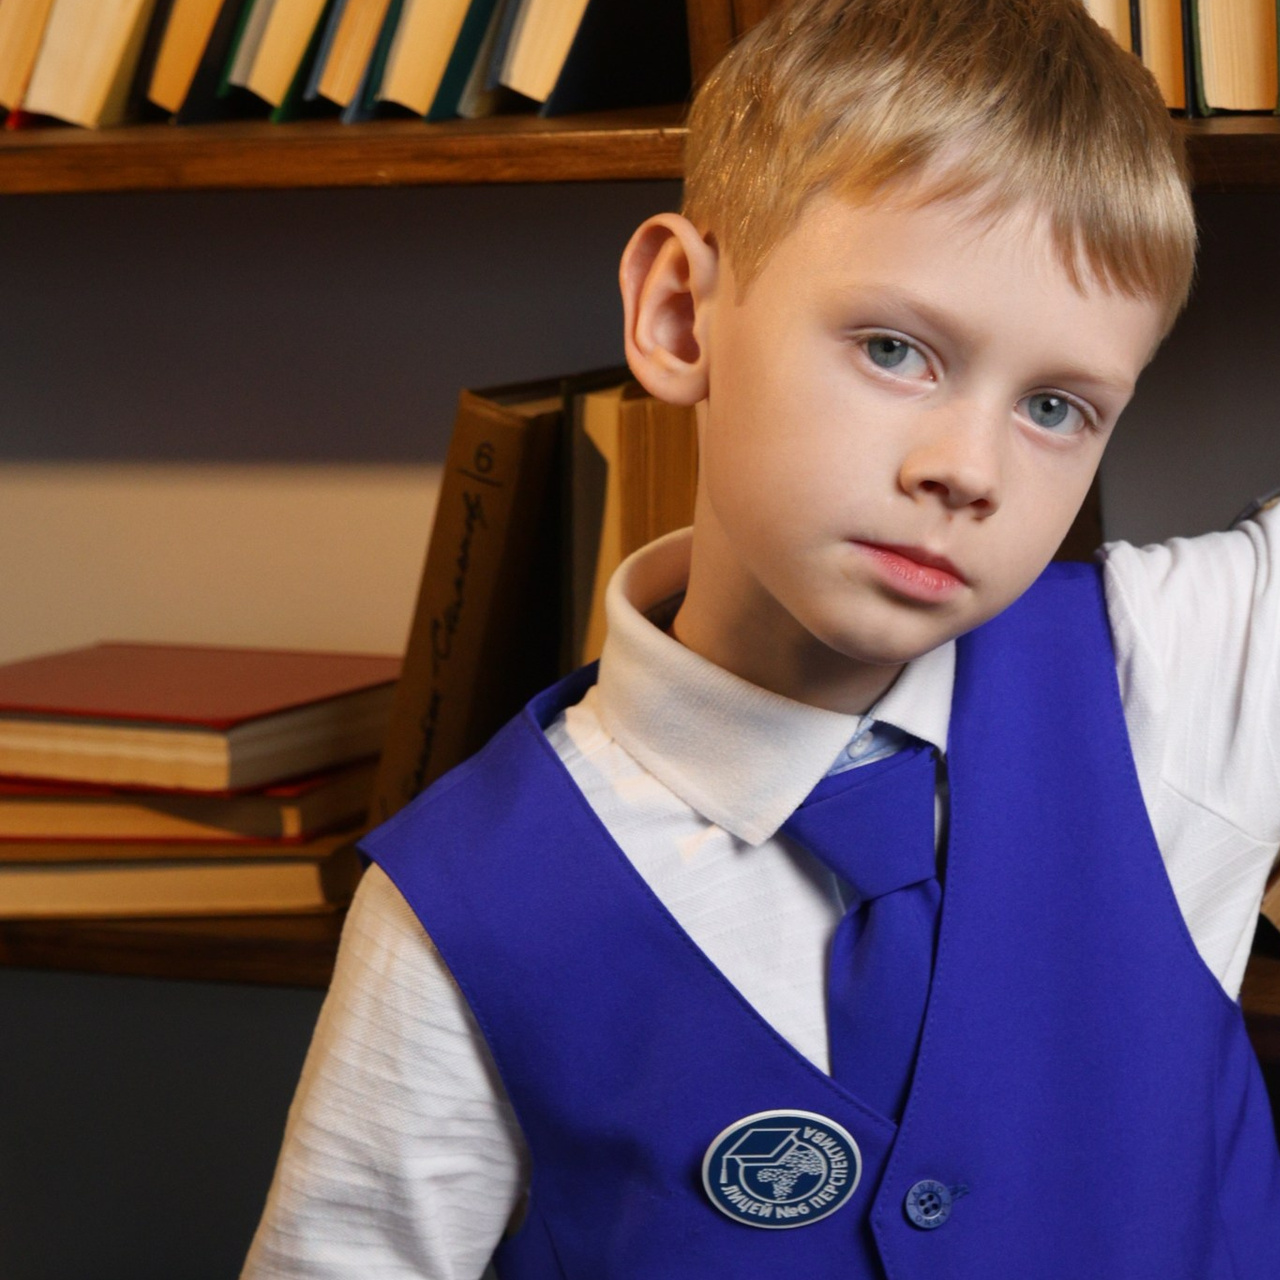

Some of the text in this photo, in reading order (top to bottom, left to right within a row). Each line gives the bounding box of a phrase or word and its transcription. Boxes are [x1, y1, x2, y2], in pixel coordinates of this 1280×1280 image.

[474, 442, 495, 474] 6
[720, 1126, 848, 1219] ЛИЦЕЙ №6 ПЕРСПЕКТИВА
